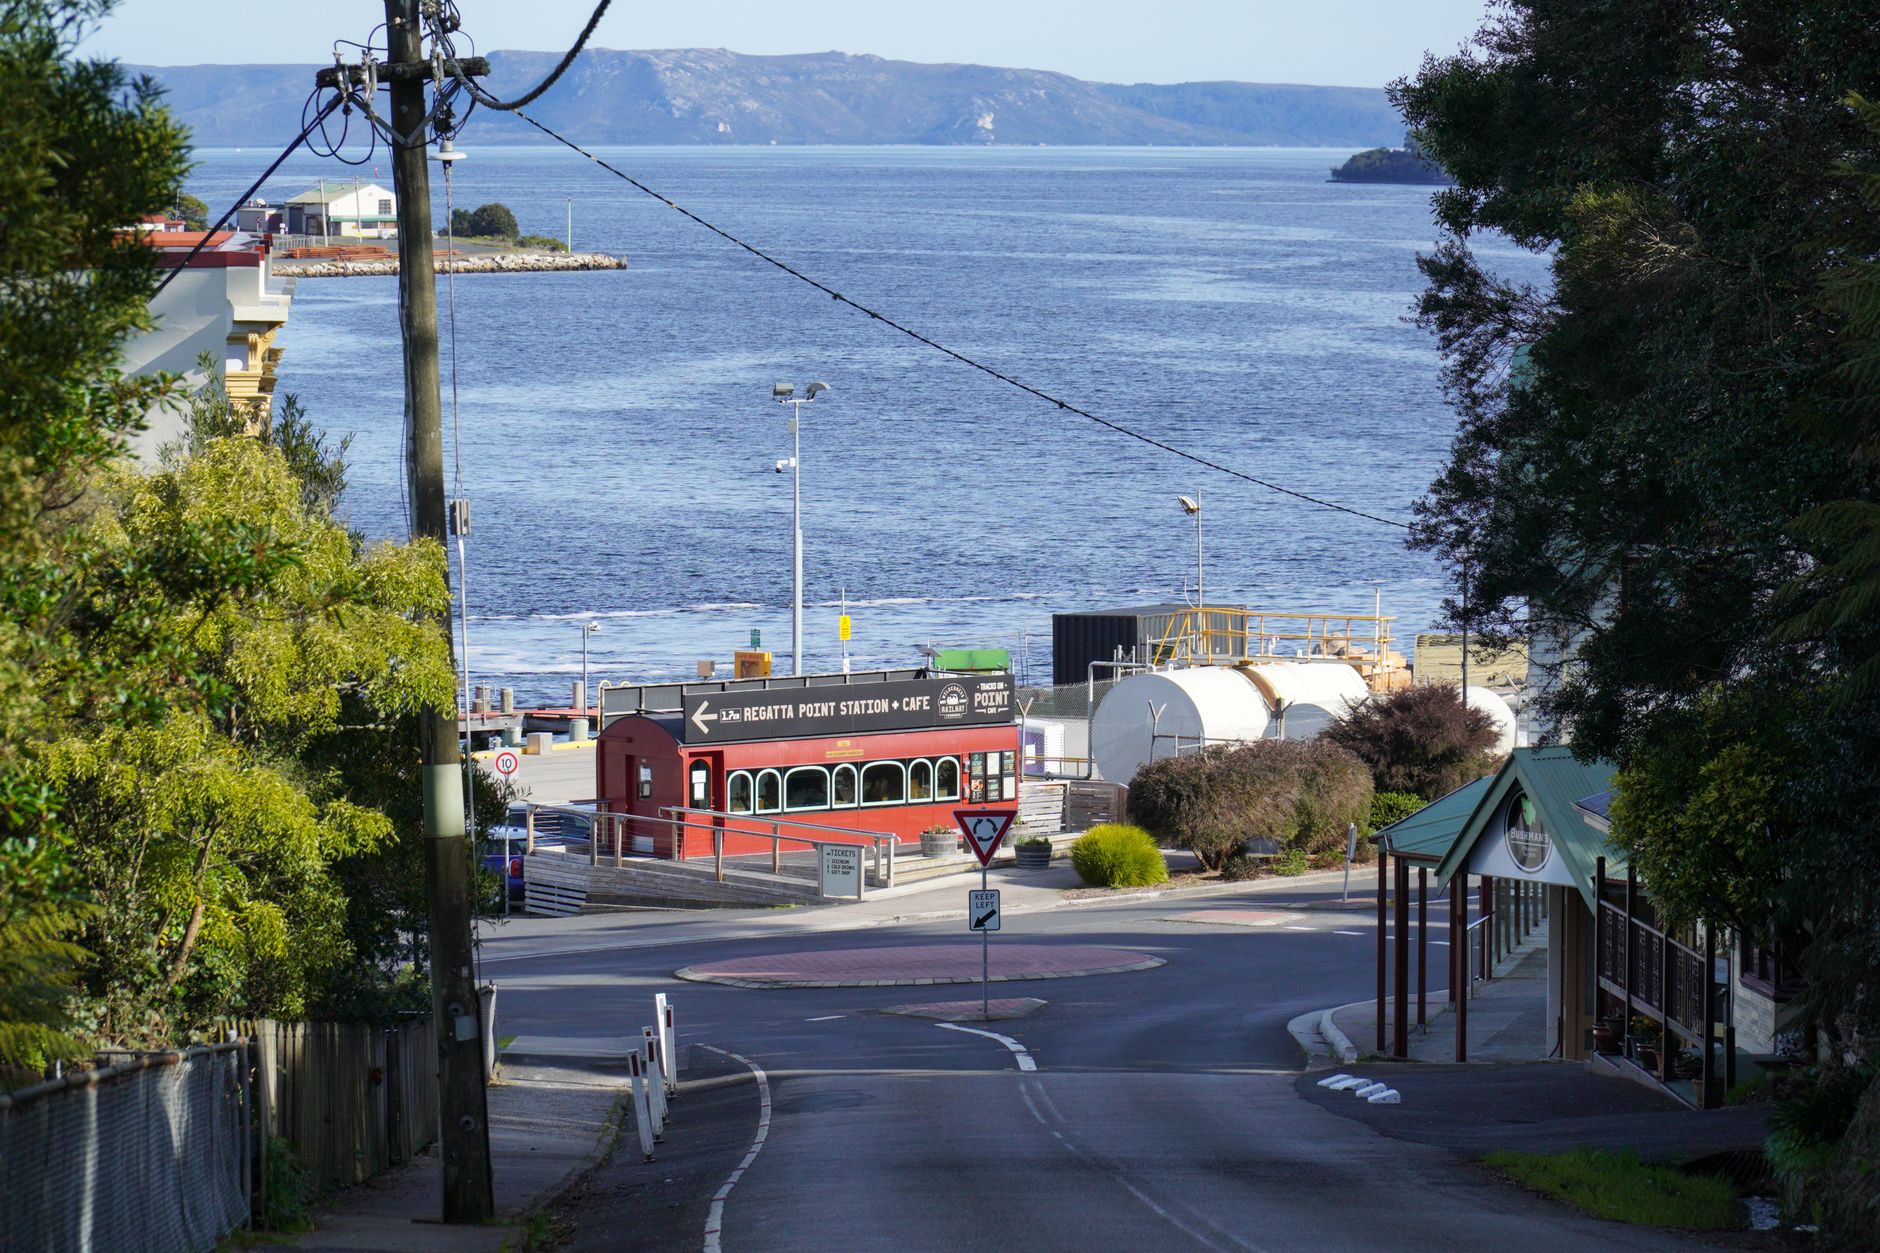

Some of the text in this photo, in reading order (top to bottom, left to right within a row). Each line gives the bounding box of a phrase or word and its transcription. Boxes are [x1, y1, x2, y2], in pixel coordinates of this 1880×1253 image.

[980, 682, 1004, 690] TRACKS ON
[974, 691, 1010, 707] POINT
[744, 704, 794, 722] REGATTA
[799, 702, 836, 718] POINT
[840, 699, 889, 716] STATION
[902, 696, 930, 711] CAFE
[941, 705, 965, 713] RAILWAY
[501, 758, 512, 769] 10
[831, 849, 856, 858] TICKETS
